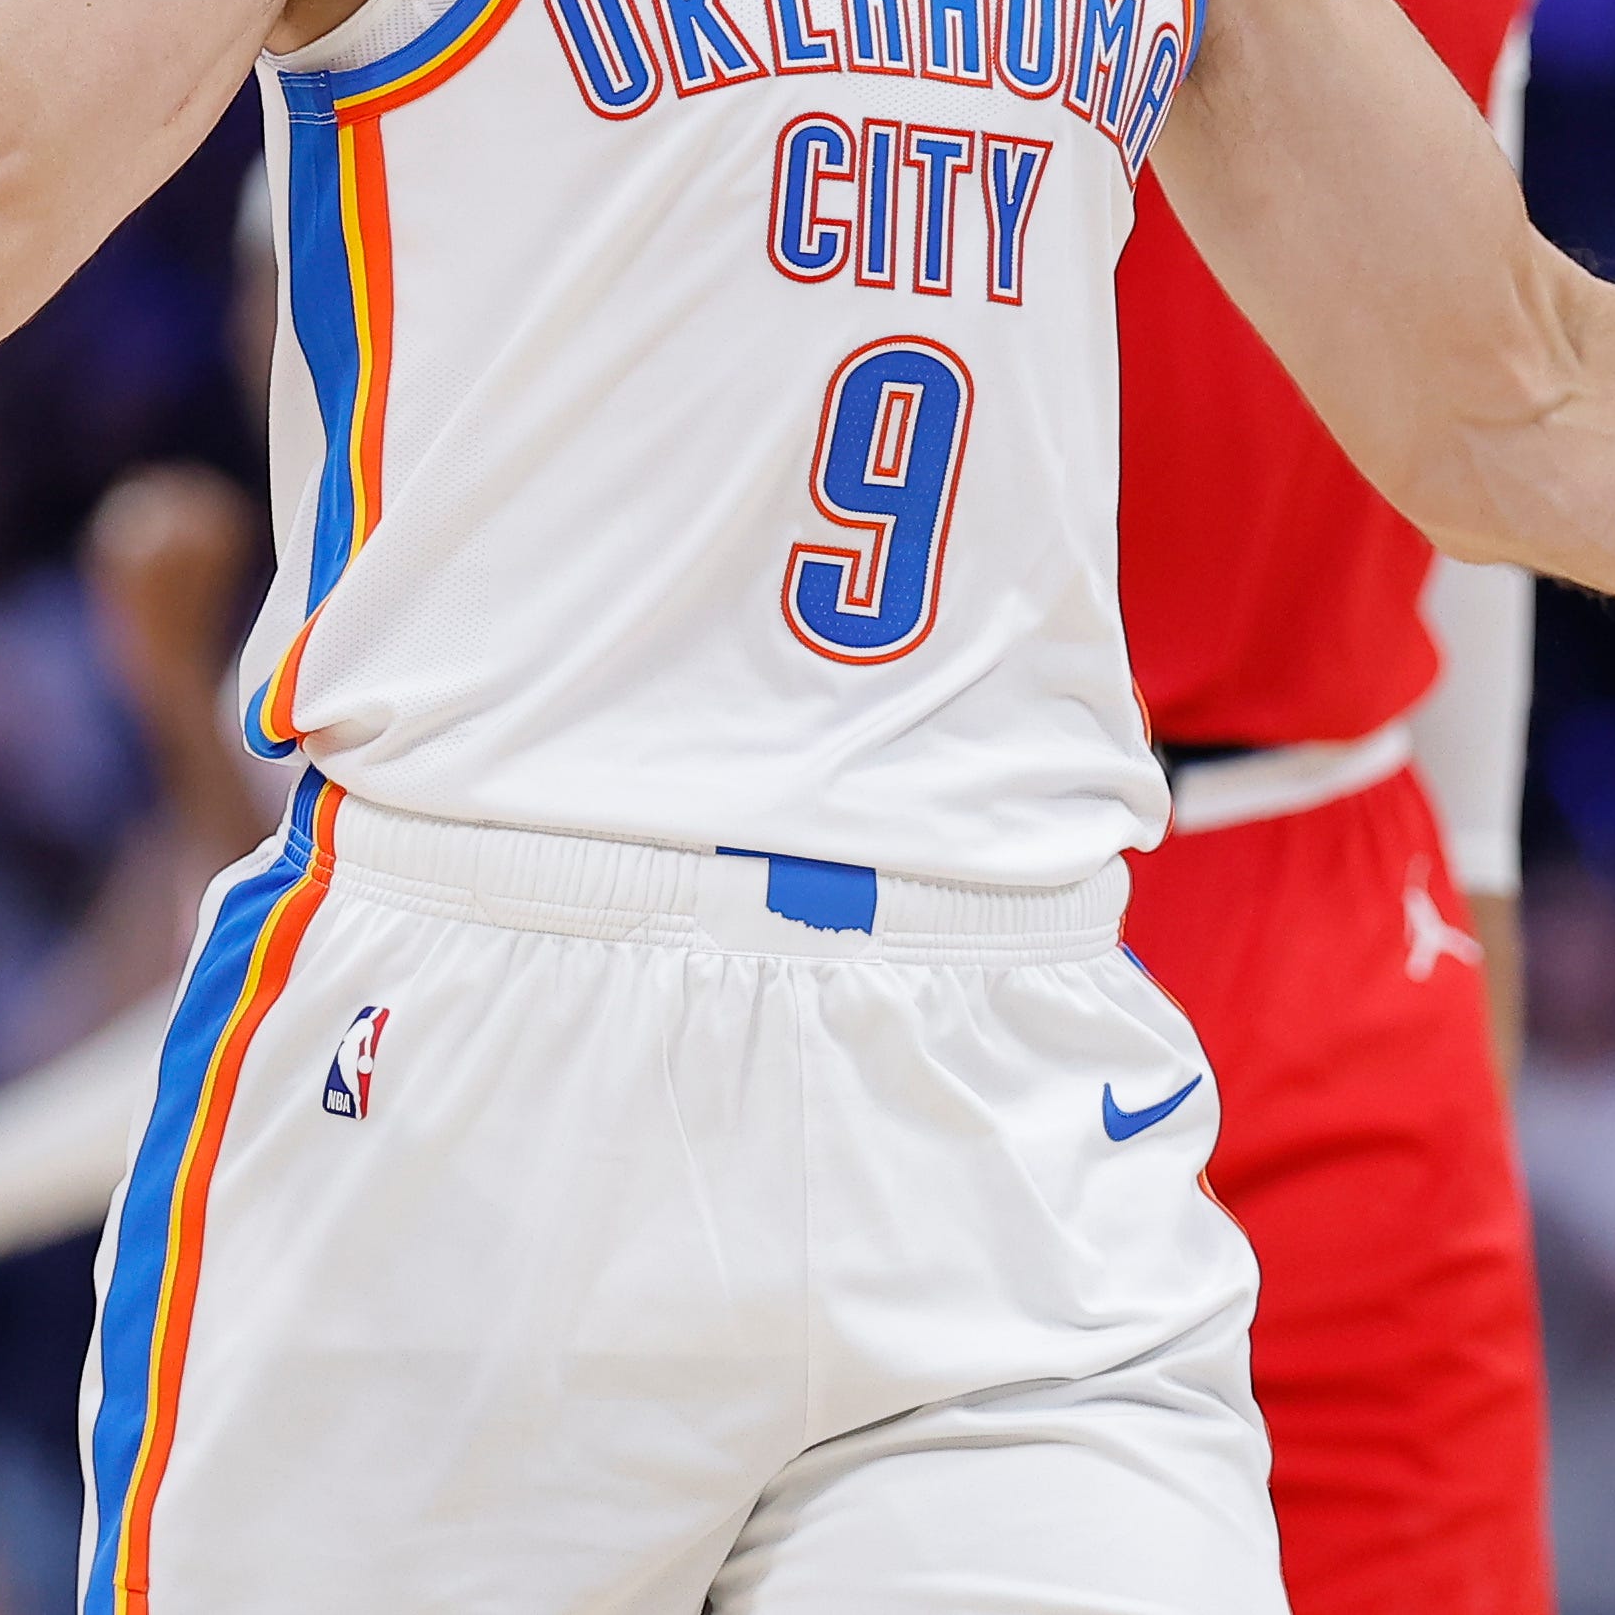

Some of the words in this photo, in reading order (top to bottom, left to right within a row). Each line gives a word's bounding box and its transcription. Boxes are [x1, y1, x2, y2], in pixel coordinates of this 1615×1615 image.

[767, 111, 1053, 306] CITY
[781, 334, 974, 666] 9
[327, 1089, 351, 1114] NBA
